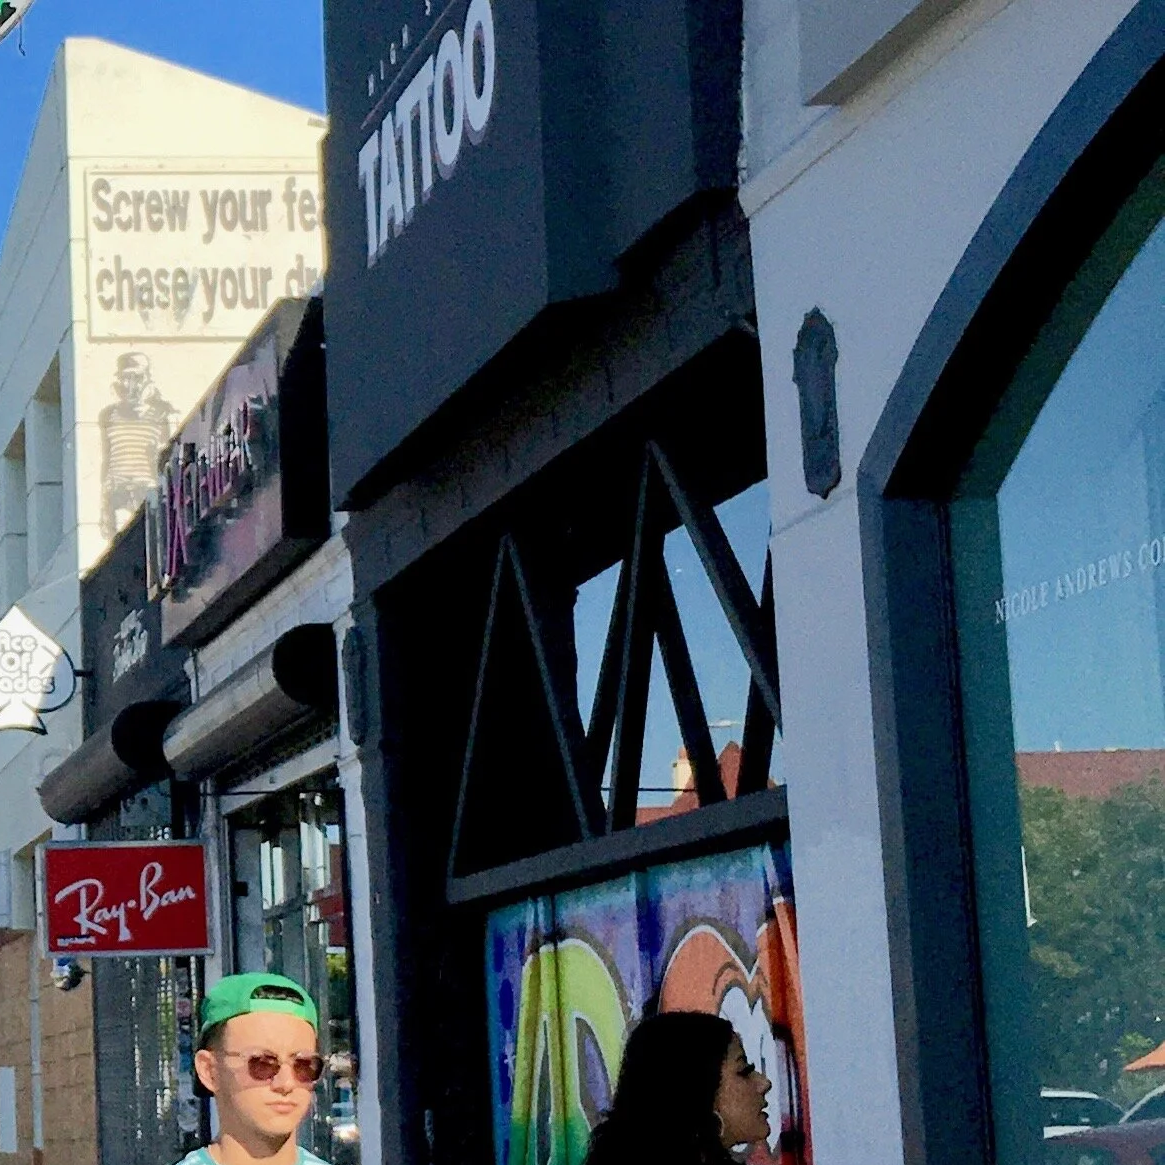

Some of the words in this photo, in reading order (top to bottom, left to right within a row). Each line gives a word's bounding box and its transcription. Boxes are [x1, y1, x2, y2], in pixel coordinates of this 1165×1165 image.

[358, 0, 495, 257] TATTOO
[91, 177, 190, 233] Screw
[199, 188, 272, 244] your
[282, 176, 319, 233] fe
[95, 254, 190, 312] chase
[199, 266, 273, 324] your
[285, 253, 319, 297] dr
[995, 581, 1050, 624] NICOLE
[1055, 550, 1132, 600] ANDREWS
